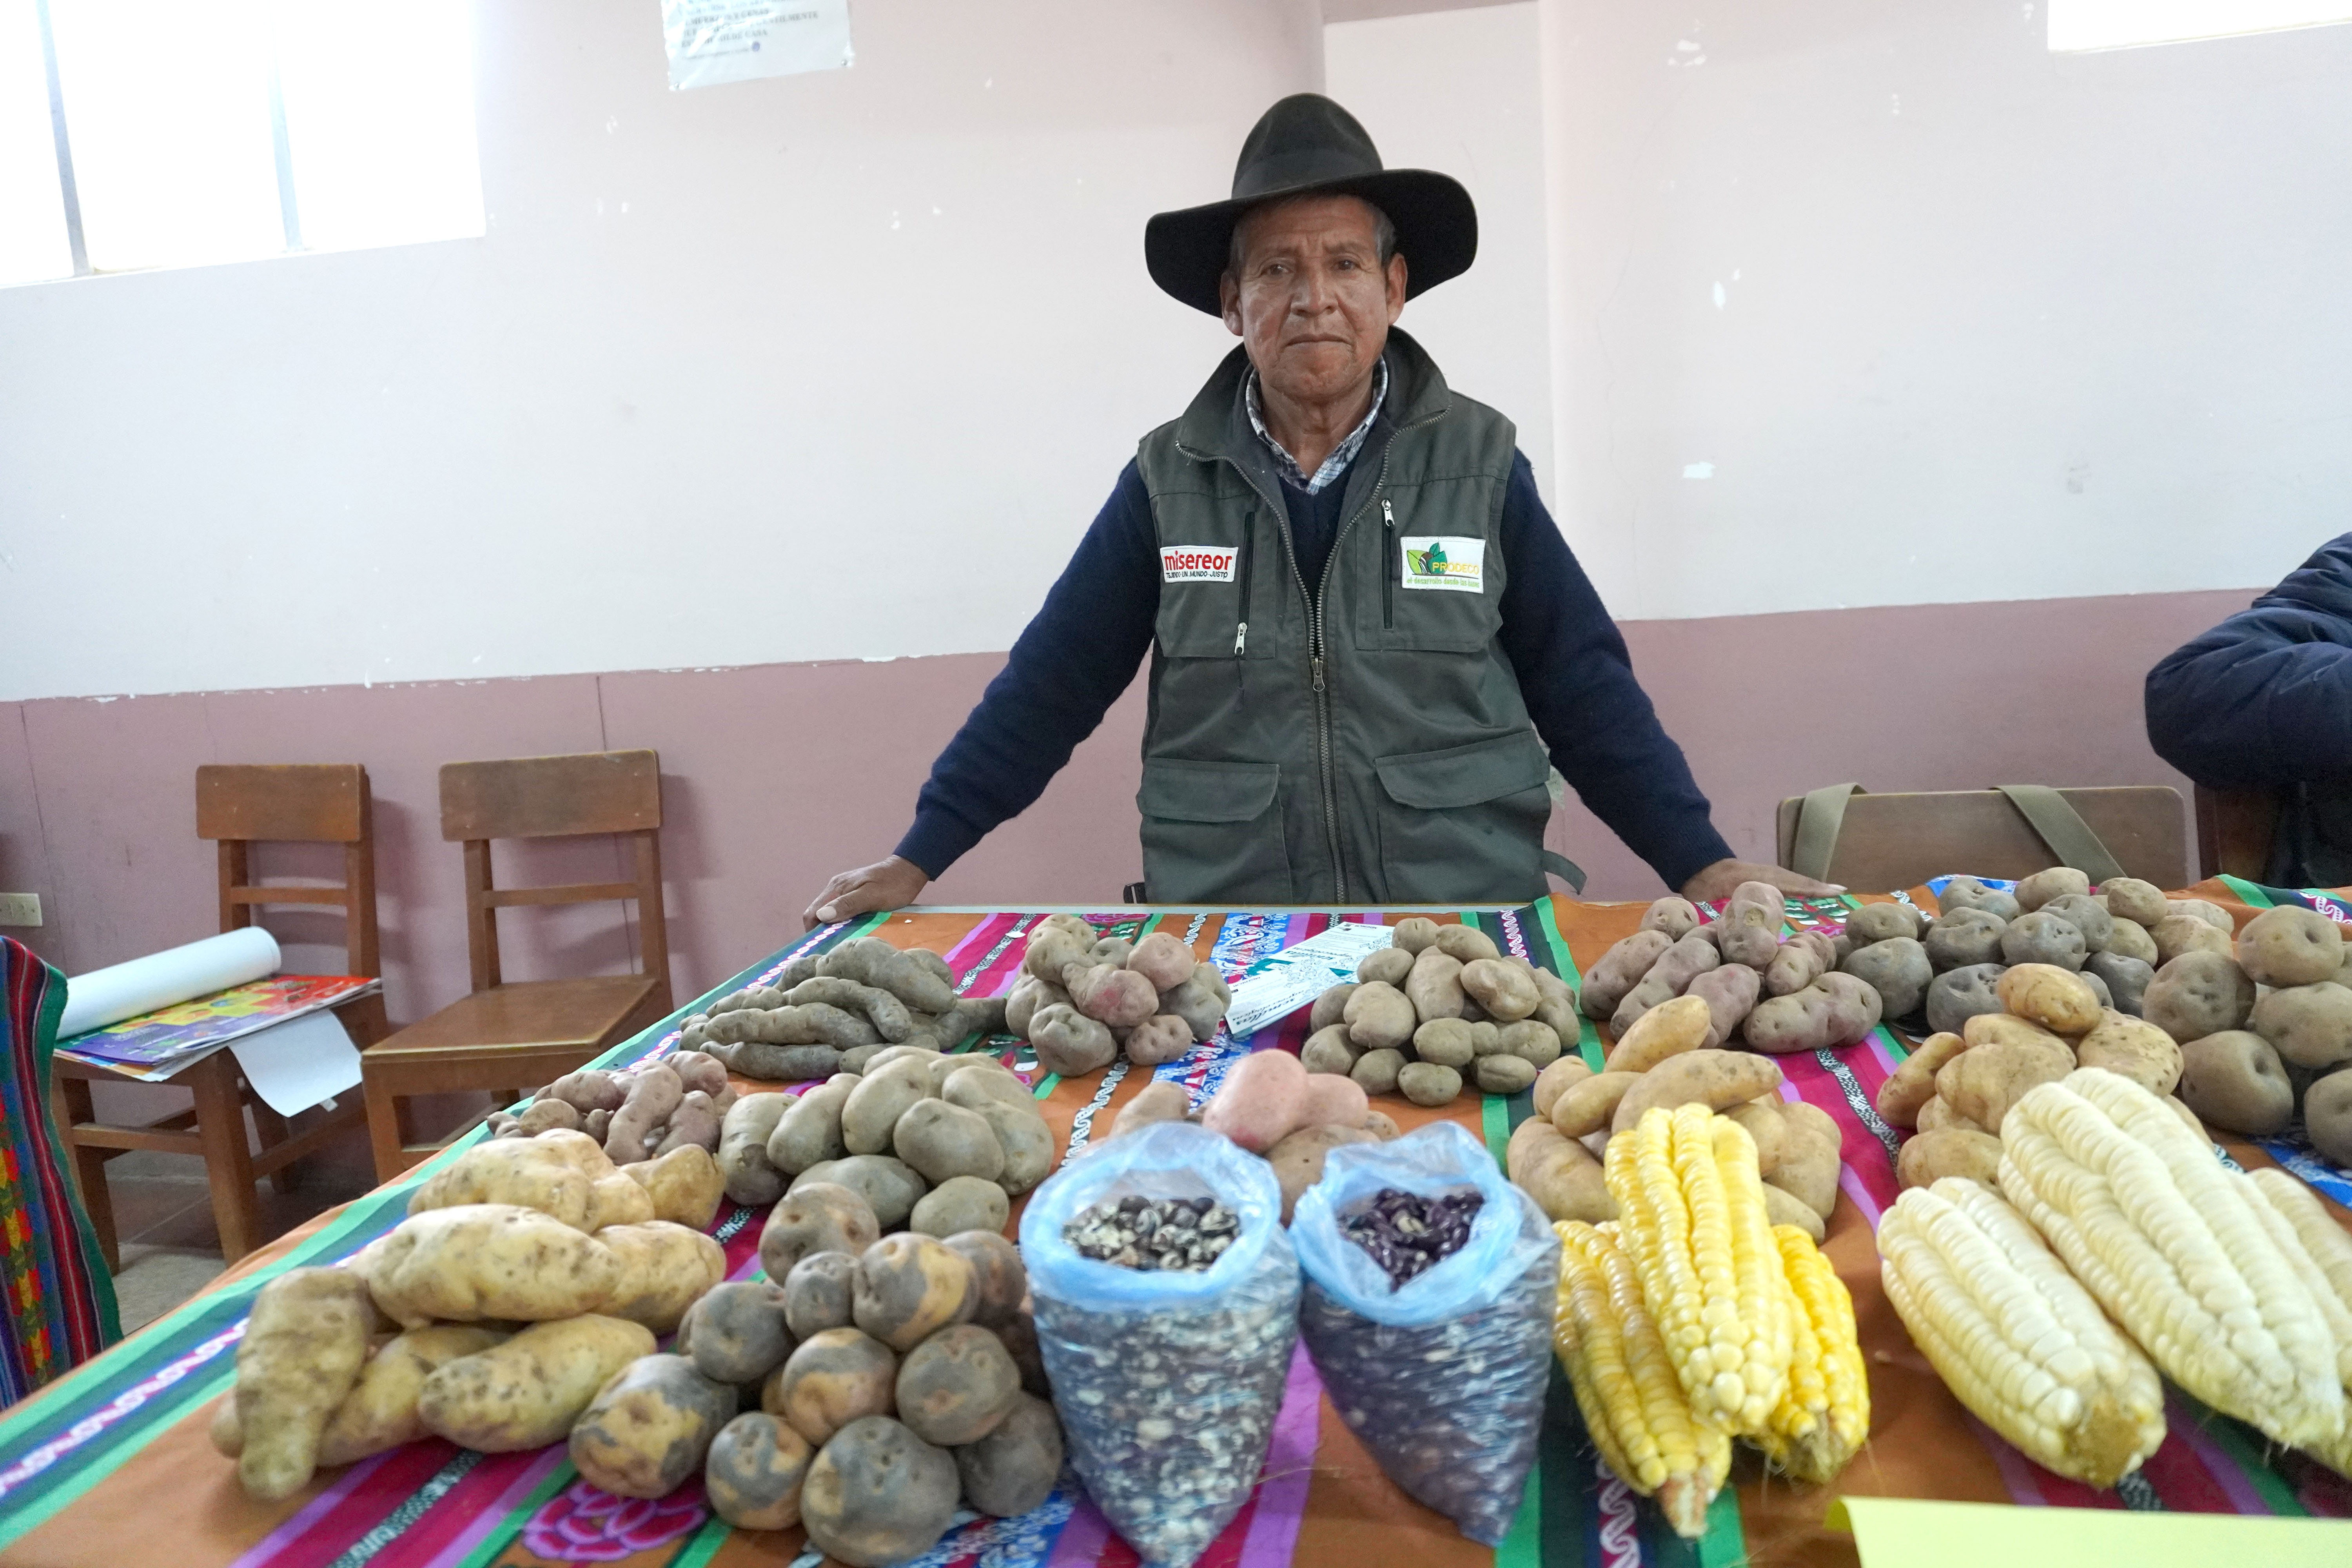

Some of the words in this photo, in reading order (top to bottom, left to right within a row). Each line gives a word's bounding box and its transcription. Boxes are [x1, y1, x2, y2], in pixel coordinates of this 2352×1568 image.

[1164, 550, 1232, 570] misereor
[1432, 562, 1479, 575] PRODECO
[1414, 577, 1442, 585] desarrollo
[1236, 998, 1295, 1026] semillas
